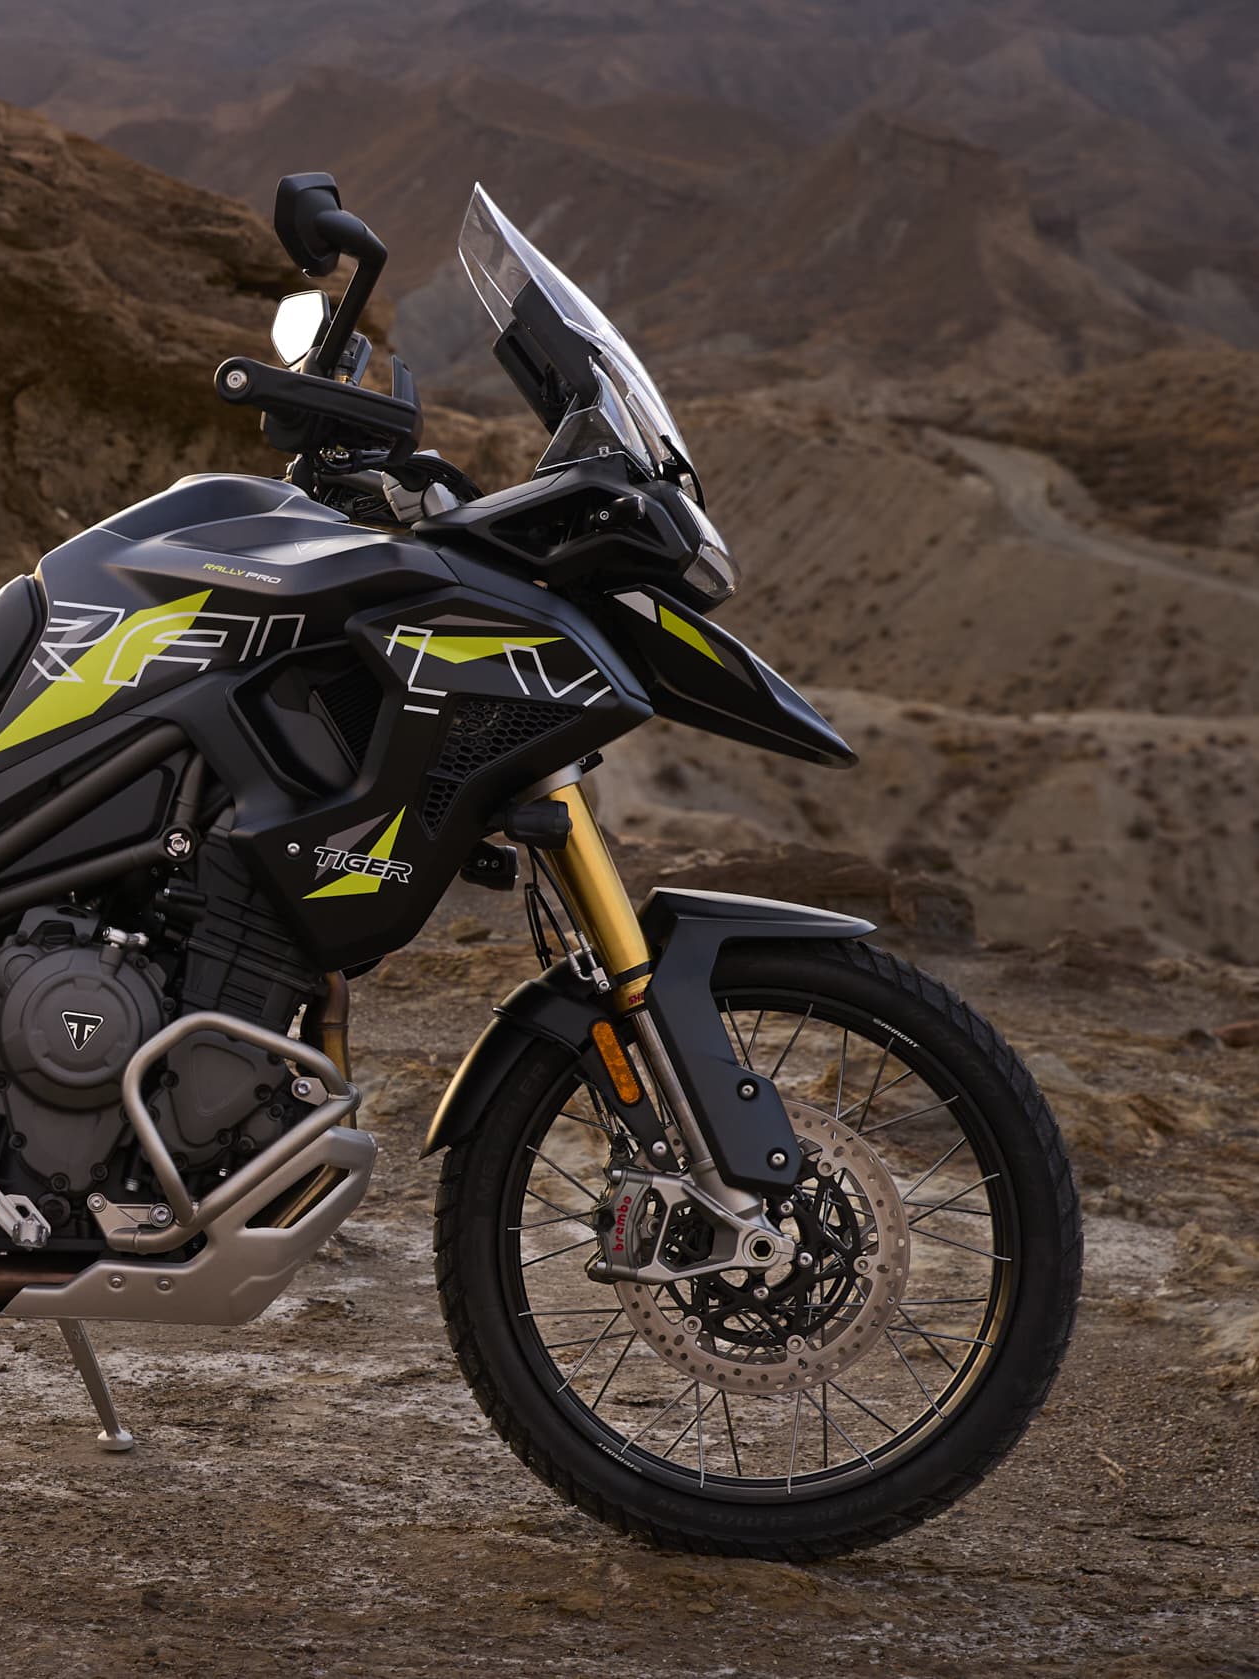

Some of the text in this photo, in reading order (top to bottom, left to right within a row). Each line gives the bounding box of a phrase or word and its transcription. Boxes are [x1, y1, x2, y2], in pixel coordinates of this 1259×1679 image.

[203, 563, 282, 584] RALLY PRO
[313, 846, 413, 884] TIGER
[612, 1195, 632, 1252] brembo
